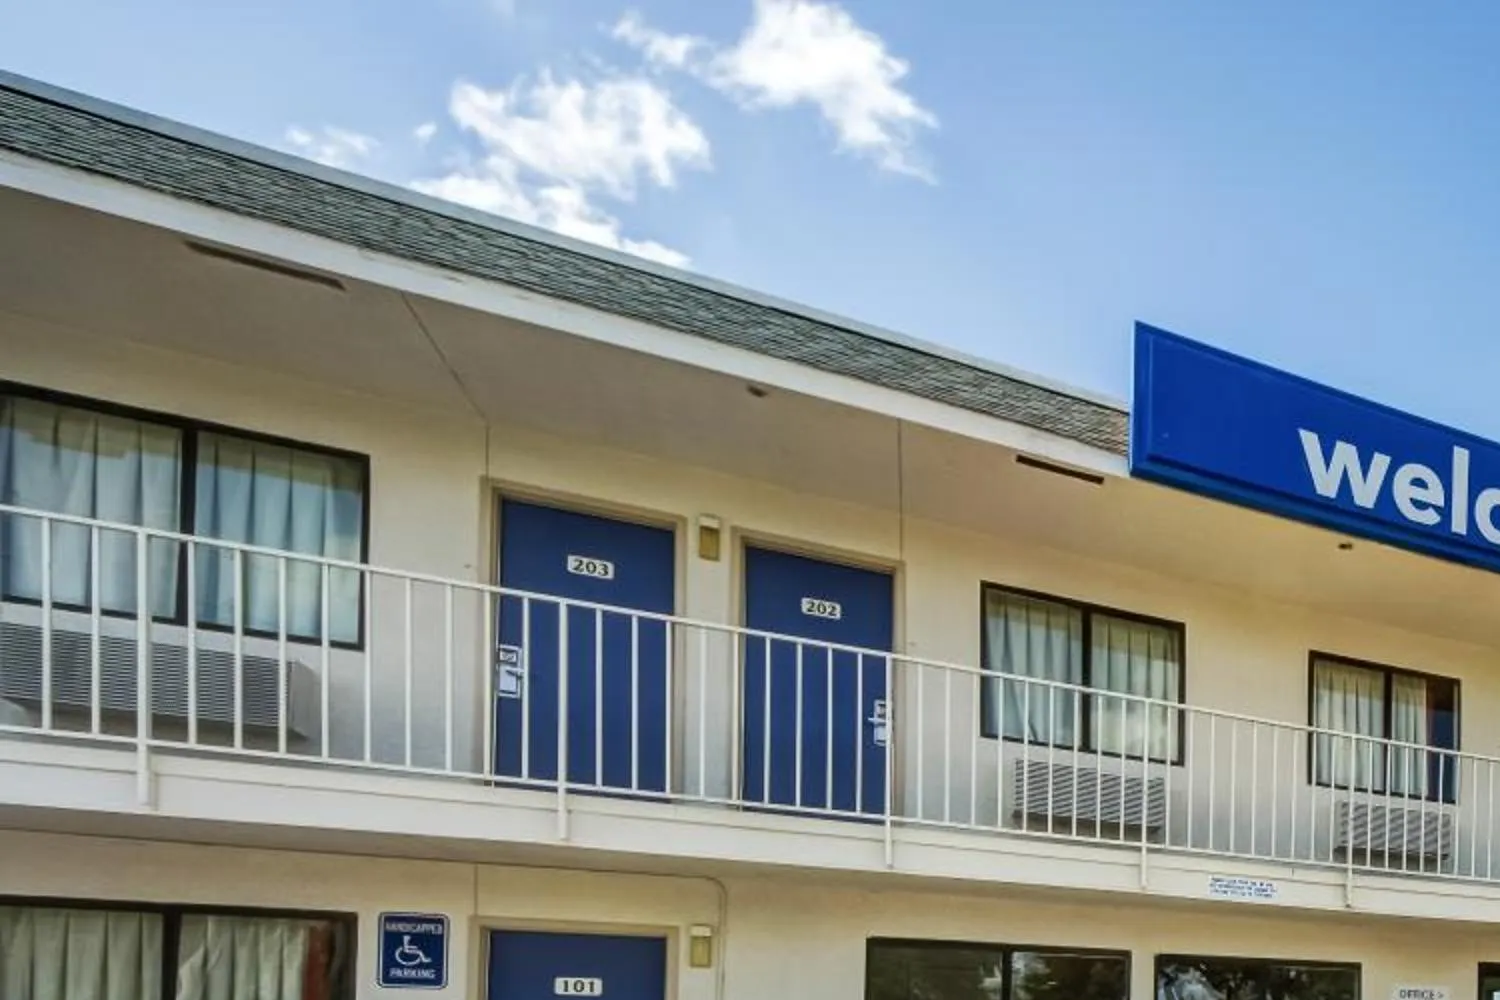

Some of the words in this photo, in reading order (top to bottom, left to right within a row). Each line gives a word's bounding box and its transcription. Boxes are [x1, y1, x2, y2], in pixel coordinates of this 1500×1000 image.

[572, 558, 610, 577] 203
[805, 601, 838, 617] 202
[389, 967, 437, 979] PARKING
[562, 979, 595, 993] 101
[1399, 989, 1435, 1000] OFFICE
